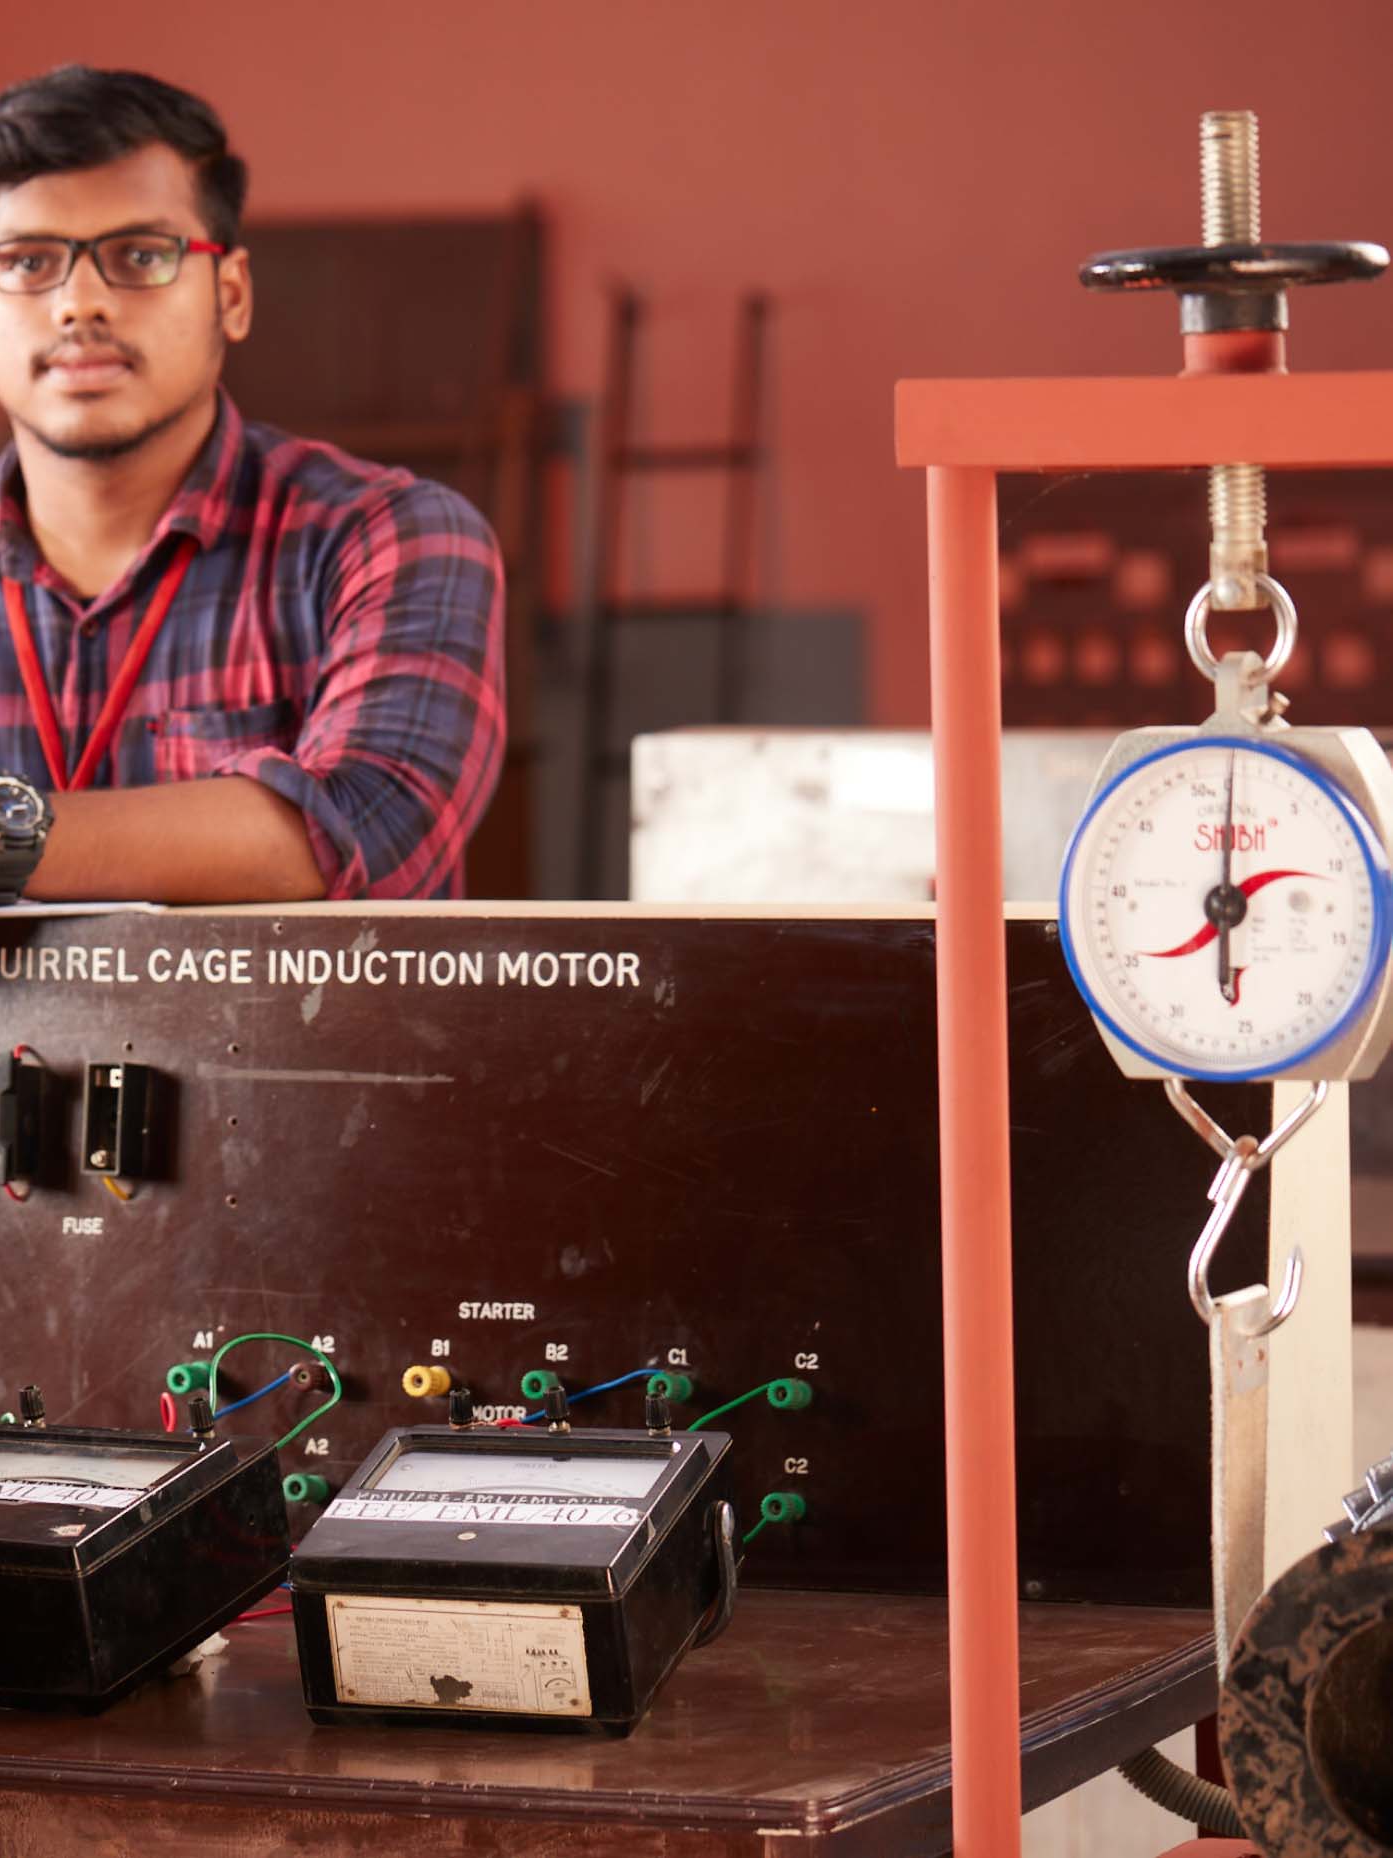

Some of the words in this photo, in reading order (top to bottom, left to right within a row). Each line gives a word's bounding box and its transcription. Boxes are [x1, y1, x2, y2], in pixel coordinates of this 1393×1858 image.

[1139, 819, 1153, 833] 45
[1328, 859, 1343, 873] 10
[1110, 884, 1126, 898] 40
[147, 948, 253, 984] CAGE
[267, 949, 484, 986] INDUCTION
[497, 951, 641, 988] MOTOR
[1238, 1020, 1254, 1034] 25
[62, 1216, 104, 1235] FUSE
[458, 1302, 536, 1320] STARTER
[192, 1331, 214, 1349] A1
[310, 1335, 335, 1353] A2
[431, 1338, 450, 1357] B1
[545, 1342, 569, 1361] B2
[667, 1348, 689, 1366] C1
[794, 1353, 819, 1370] C2
[304, 1437, 329, 1455] A2
[784, 1457, 809, 1474] C2
